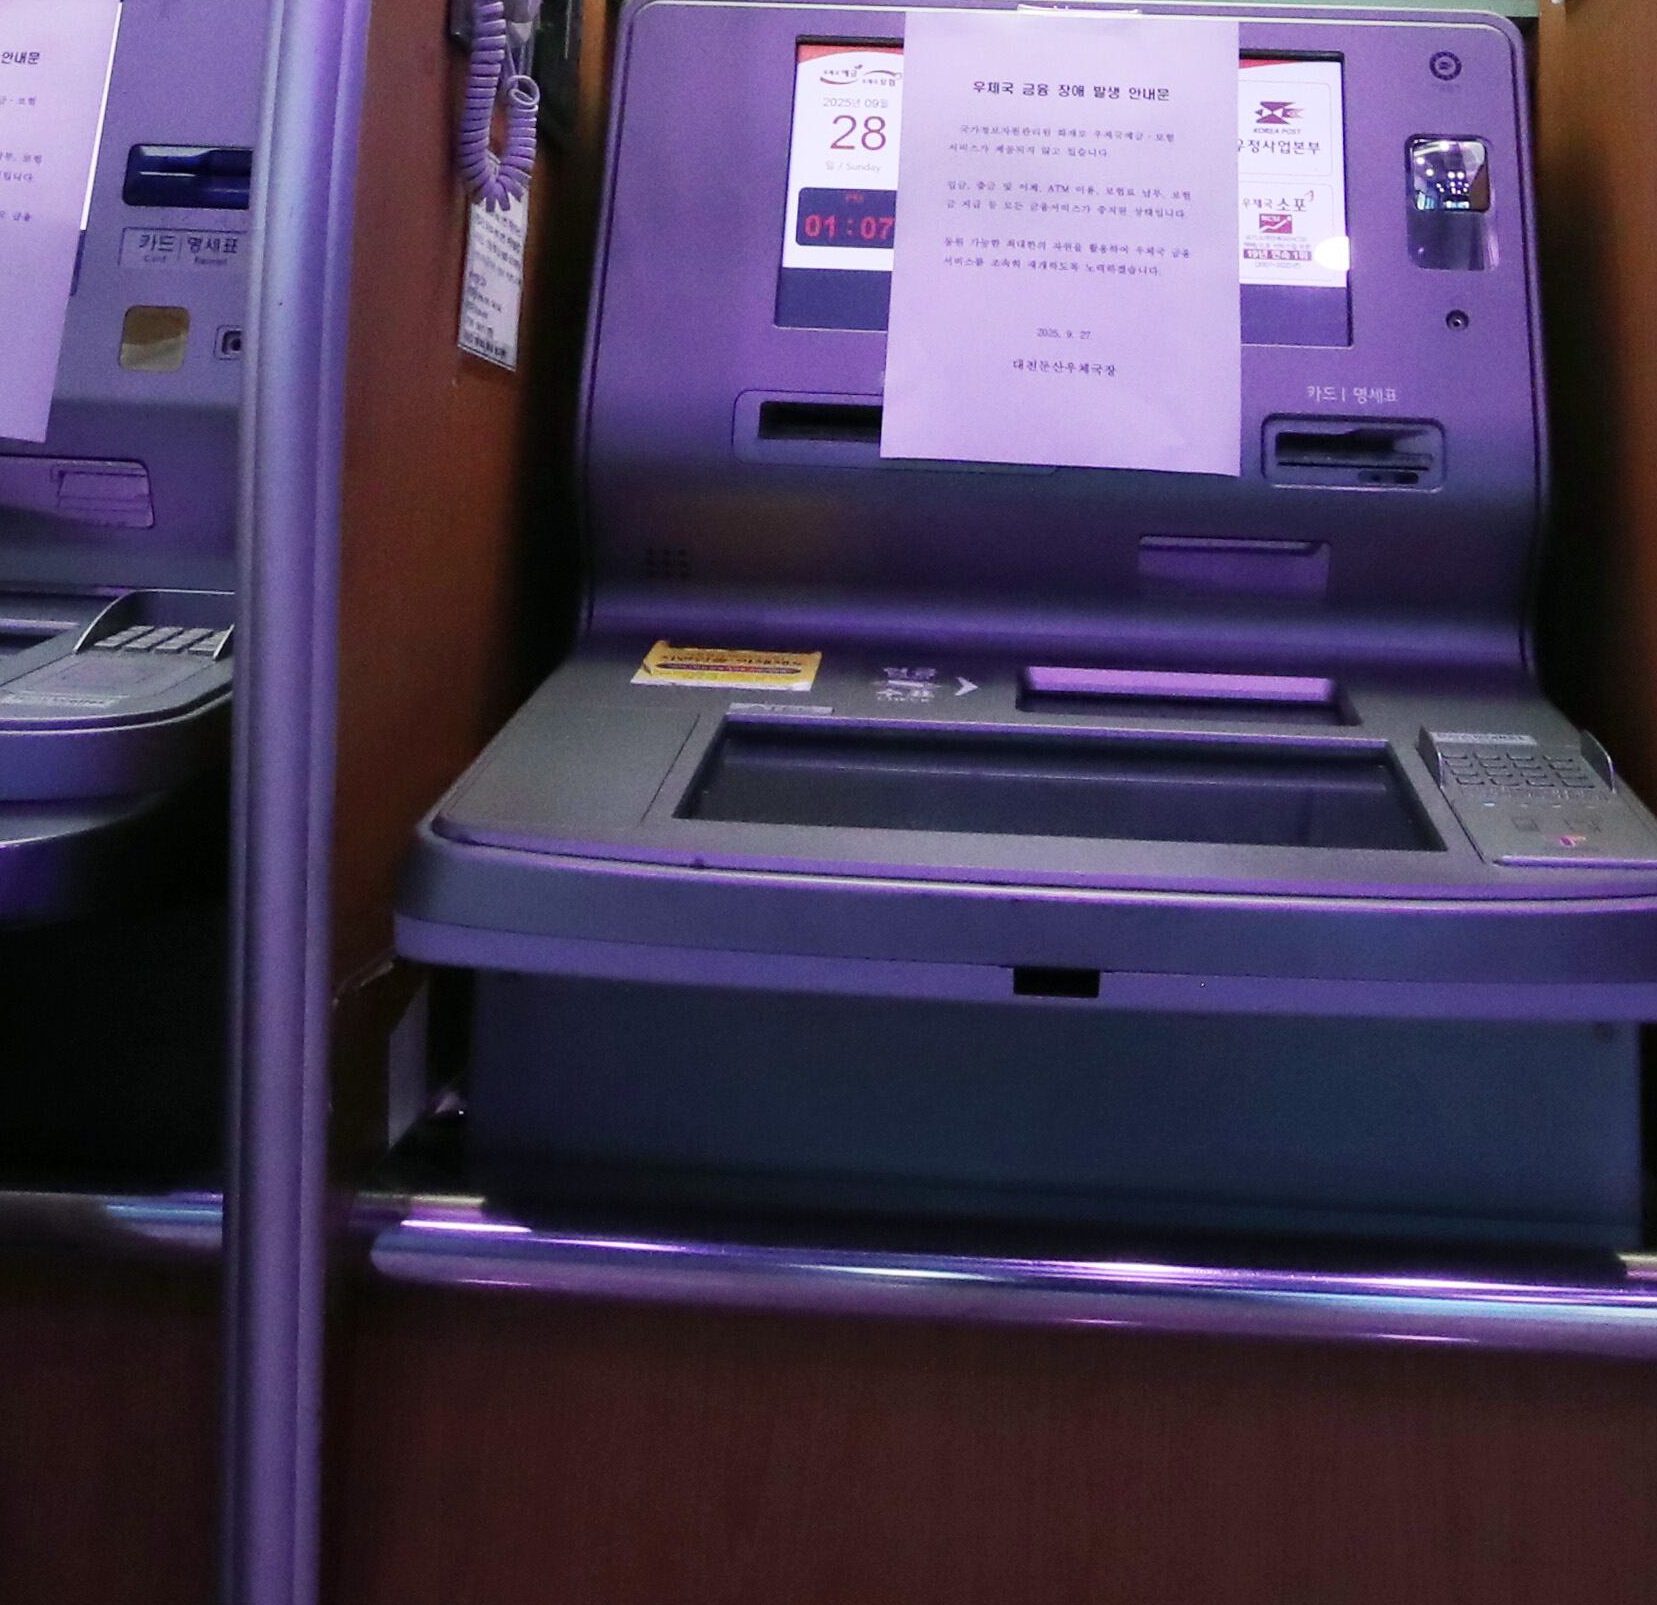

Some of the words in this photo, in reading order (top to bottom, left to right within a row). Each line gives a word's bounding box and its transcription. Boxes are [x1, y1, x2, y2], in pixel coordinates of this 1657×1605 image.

[1, 52, 41, 65] 안내문
[973, 81, 1014, 95] 우체국
[1022, 82, 1049, 97] 금융
[1058, 84, 1085, 98] 장애
[1093, 85, 1120, 99] 발생
[1128, 87, 1170, 102] 안내문
[831, 115, 887, 151] 28
[846, 162, 881, 174] Sunday
[1047, 184, 1069, 193] ATM
[140, 235, 176, 252] 카드
[188, 237, 237, 254] 명세표
[1307, 385, 1337, 403] 카드
[1353, 387, 1397, 405] 명세표
